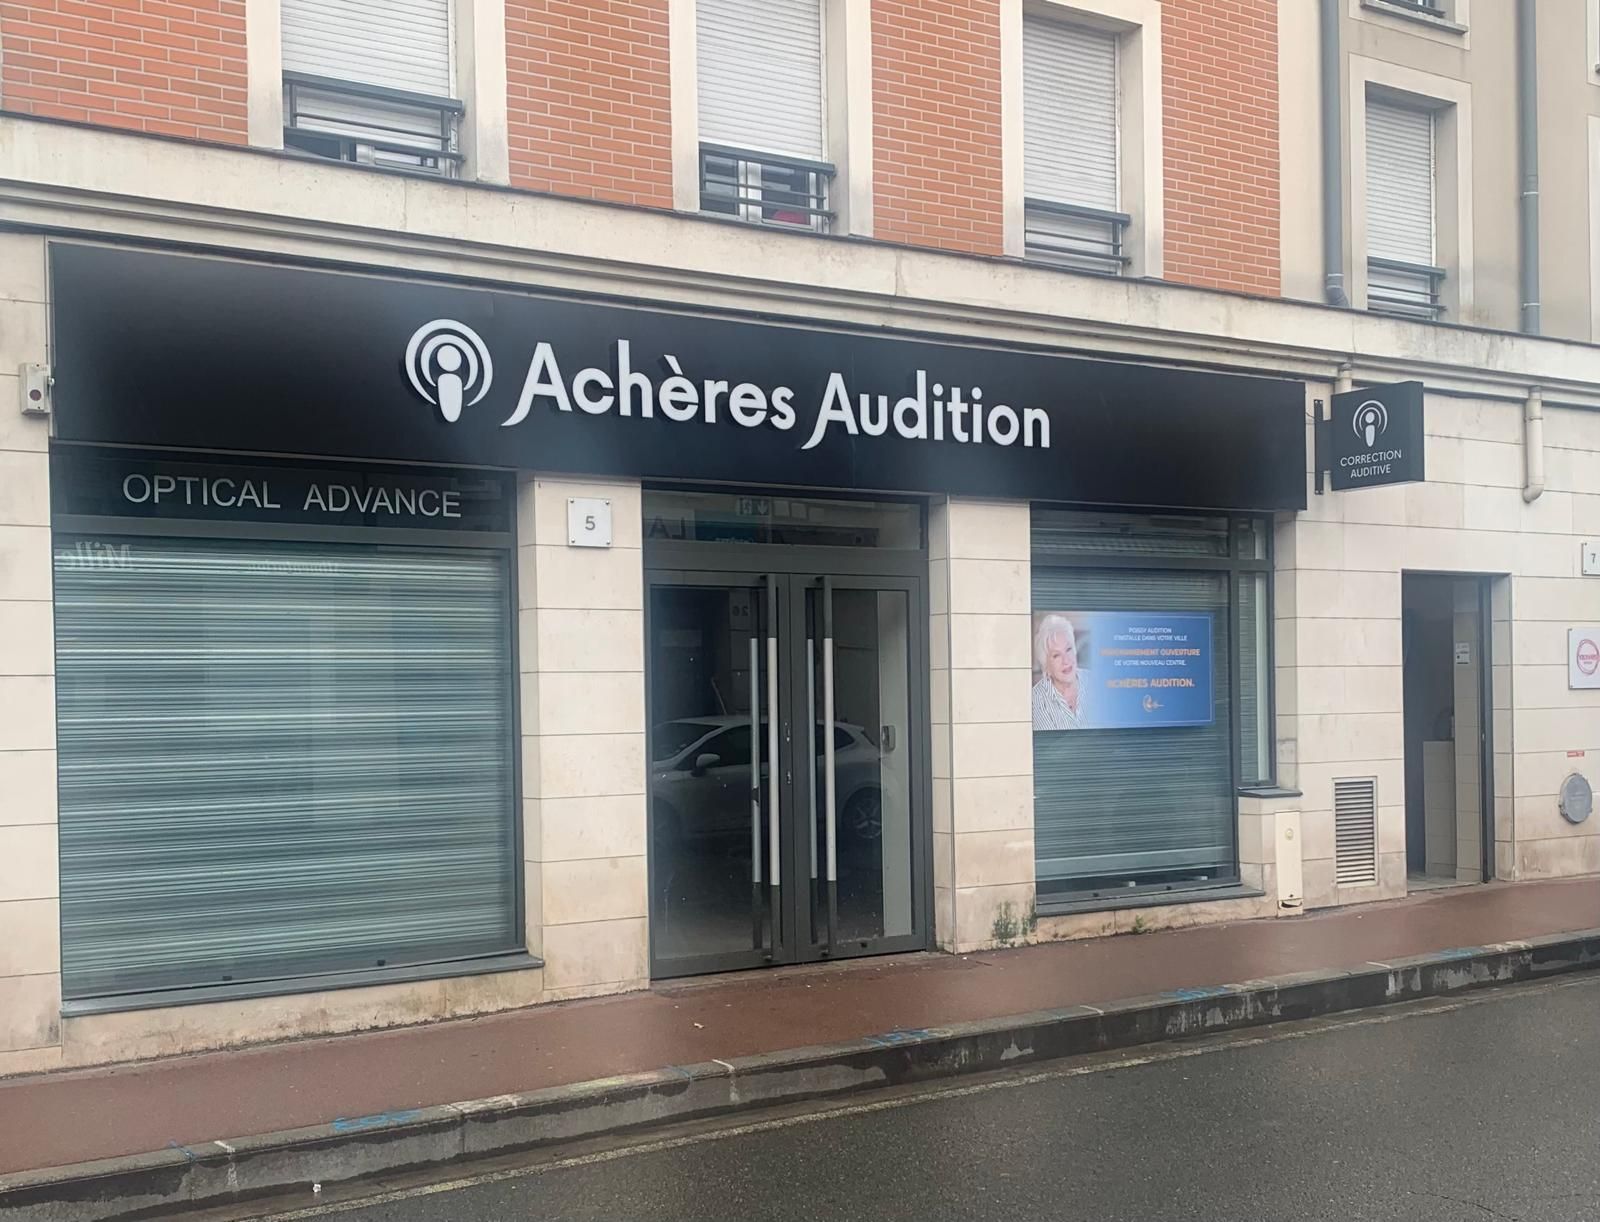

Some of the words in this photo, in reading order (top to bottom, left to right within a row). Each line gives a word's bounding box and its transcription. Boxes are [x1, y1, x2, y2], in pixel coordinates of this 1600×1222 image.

[501, 339, 796, 430] Achères
[801, 369, 1051, 449] Audition
[1340, 449, 1402, 467] CORRECTION
[1350, 463, 1391, 478] AUDITIVE
[122, 473, 281, 508] OPTICAL
[303, 483, 462, 518] ADVANCE
[585, 516, 596, 531] 5
[1590, 552, 1596, 564] 7
[1160, 647, 1201, 656] OUVERTURE
[1150, 677, 1195, 688] AUDITION.
